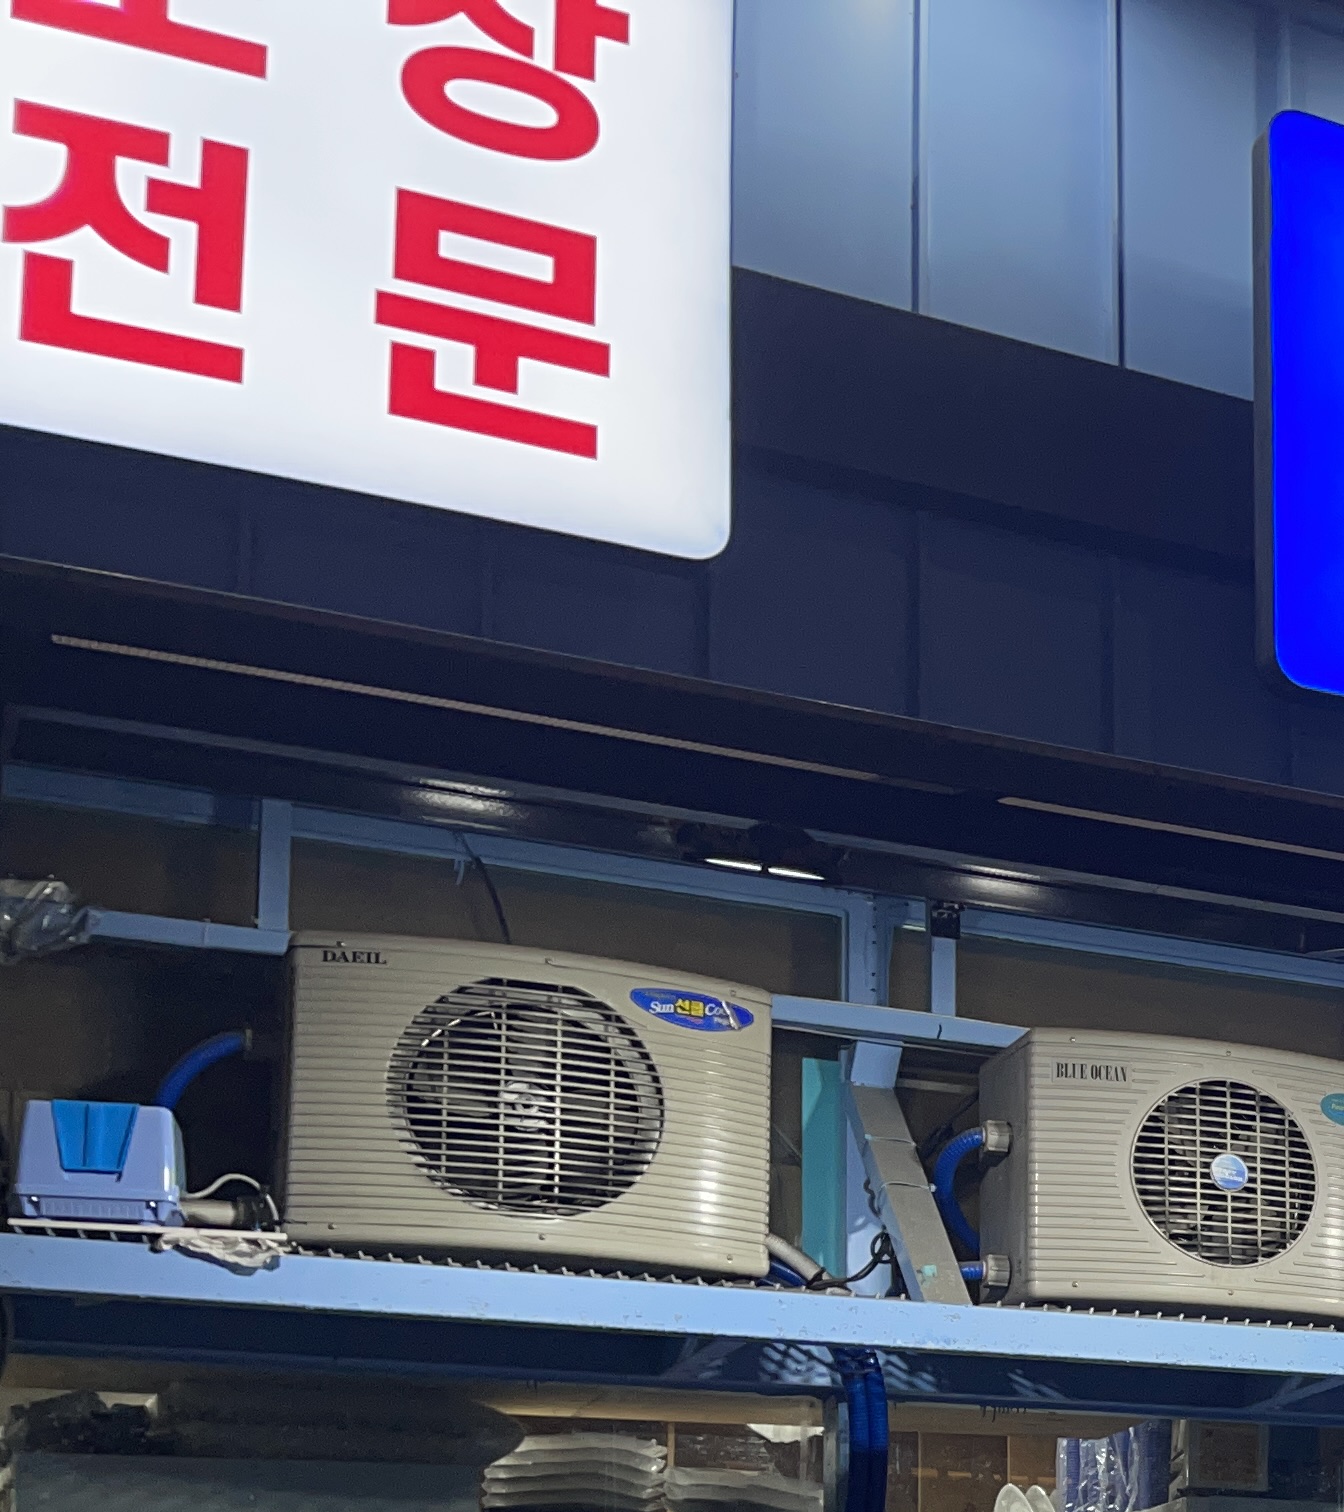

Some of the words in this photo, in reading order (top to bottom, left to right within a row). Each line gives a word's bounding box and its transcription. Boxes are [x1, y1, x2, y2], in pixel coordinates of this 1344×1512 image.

[321, 949, 388, 966] DAEIL
[1055, 1062, 1089, 1080] BLUE
[1090, 1063, 1128, 1083] OCEAN
